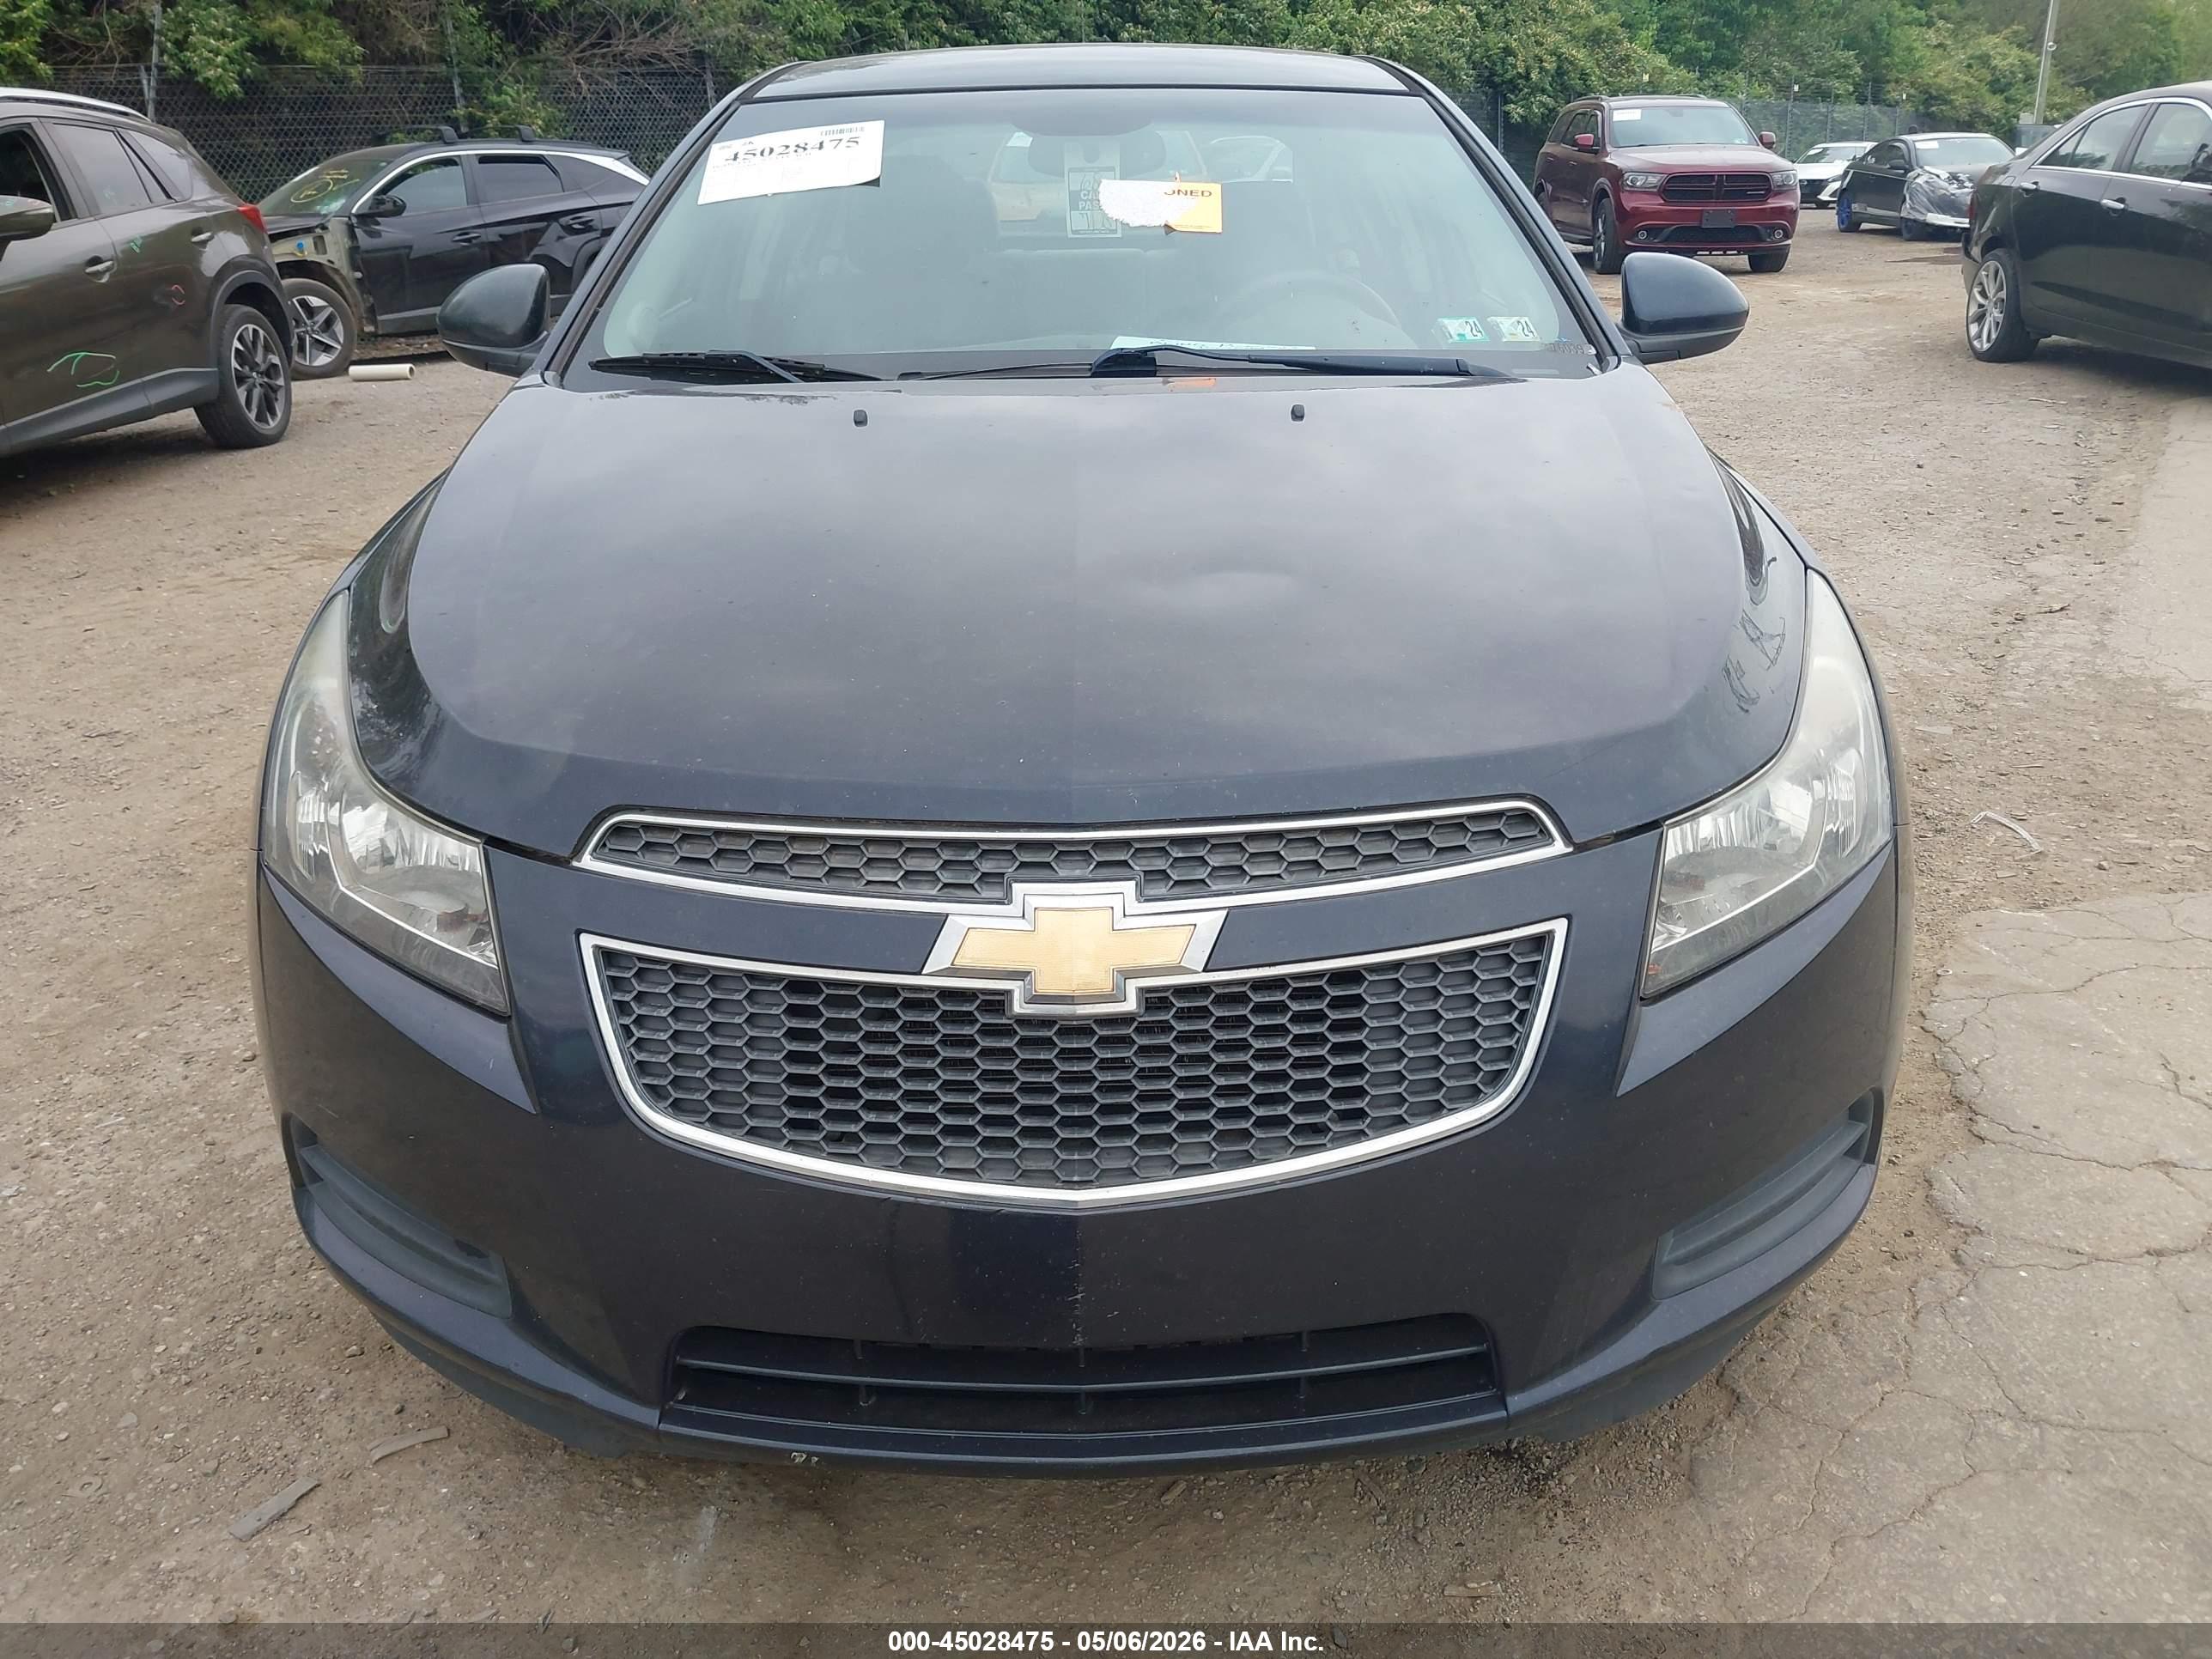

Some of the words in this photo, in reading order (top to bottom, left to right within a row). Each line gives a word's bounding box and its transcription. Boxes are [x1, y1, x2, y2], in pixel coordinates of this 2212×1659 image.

[725, 136, 861, 161] 45028475
[1465, 320, 1484, 337] 24
[1516, 320, 1535, 337] 24
